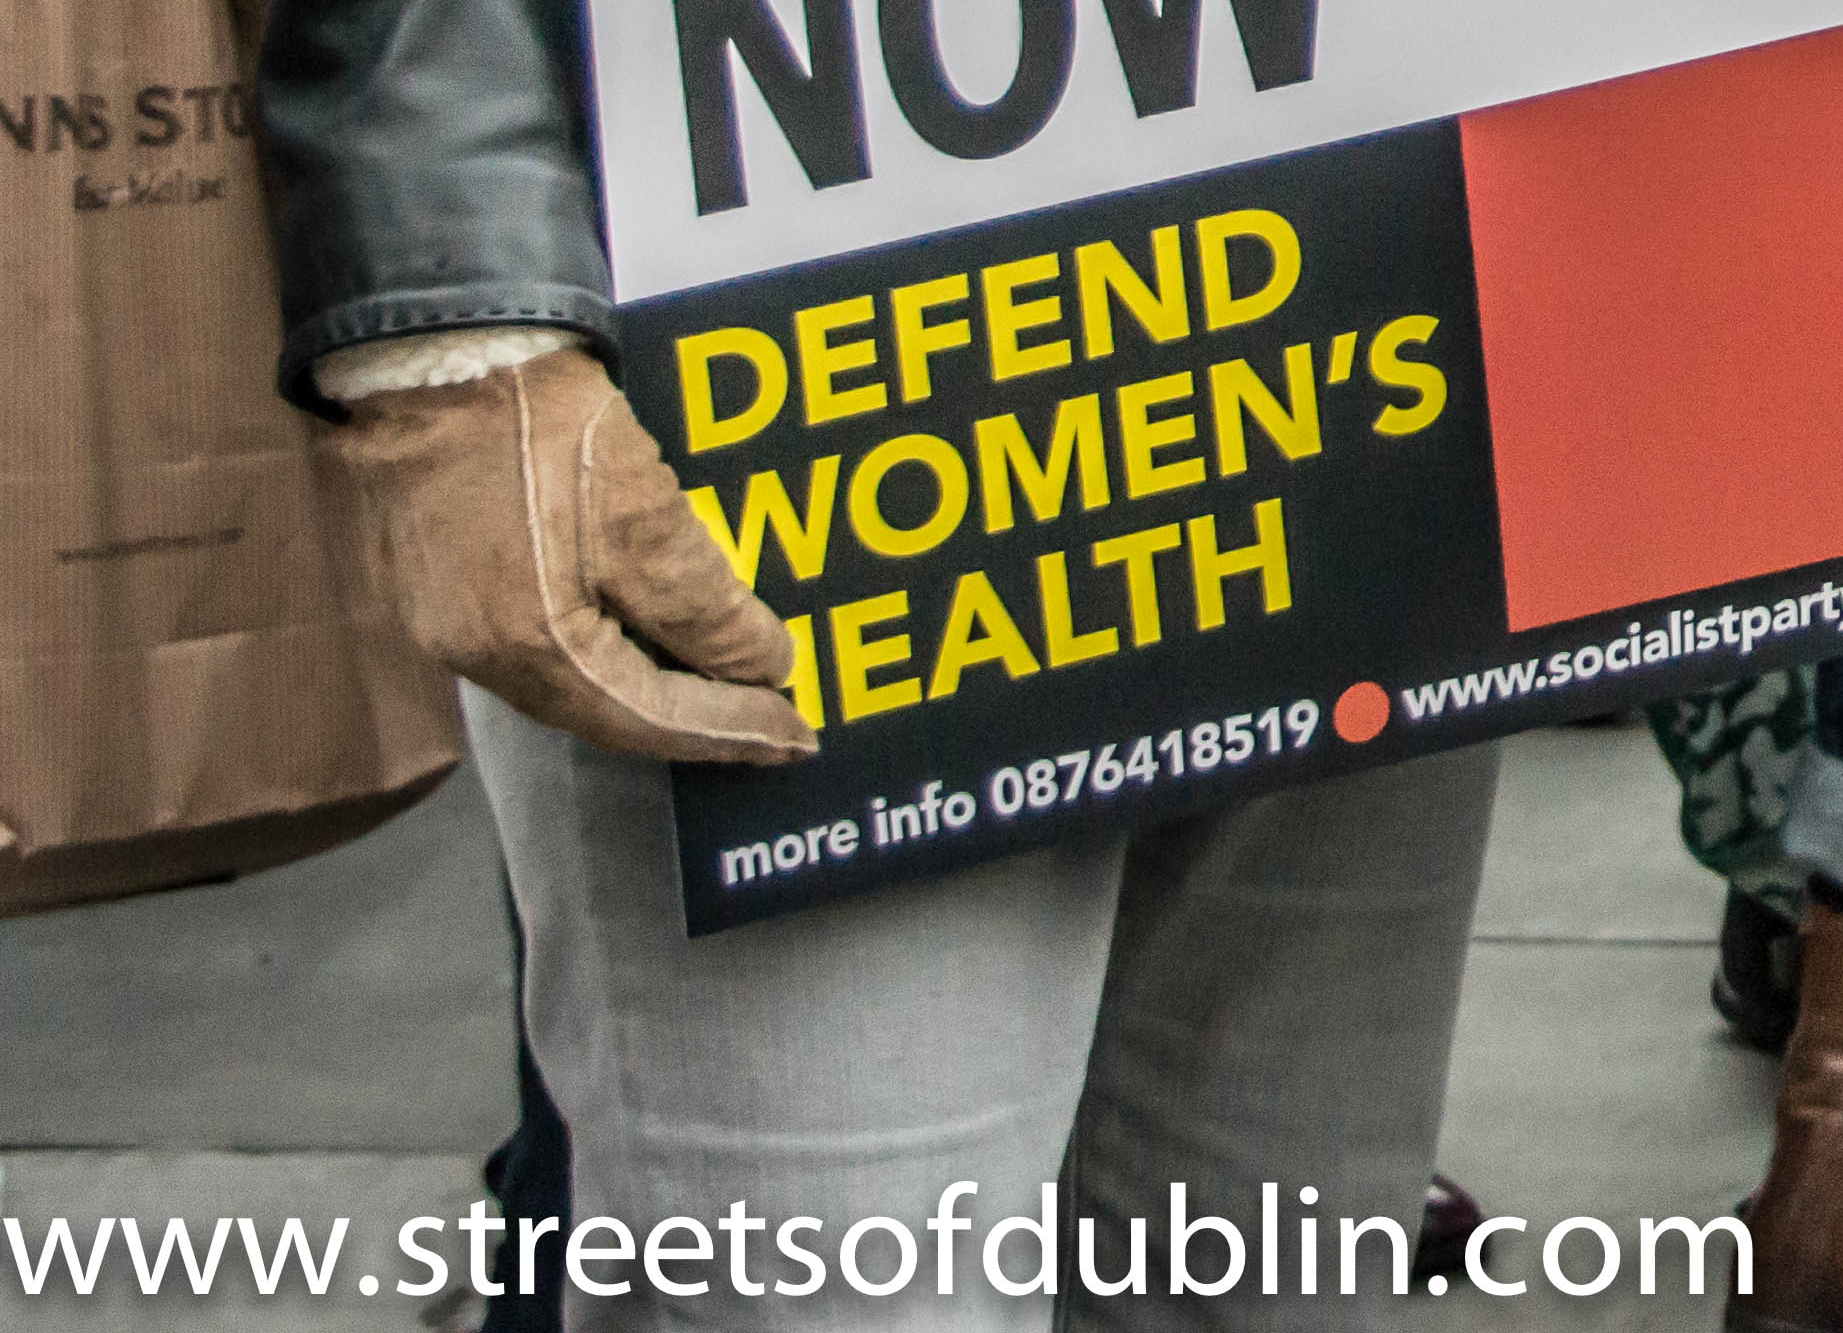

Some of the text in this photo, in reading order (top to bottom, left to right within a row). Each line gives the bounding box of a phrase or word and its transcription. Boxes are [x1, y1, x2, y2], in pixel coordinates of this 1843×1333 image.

[675, 208, 1303, 454] DEFEND
[685, 313, 1450, 591] WOMEN'S
[721, 811, 860, 887] more
[871, 777, 976, 848] info
[990, 697, 1321, 819] 0876418519
